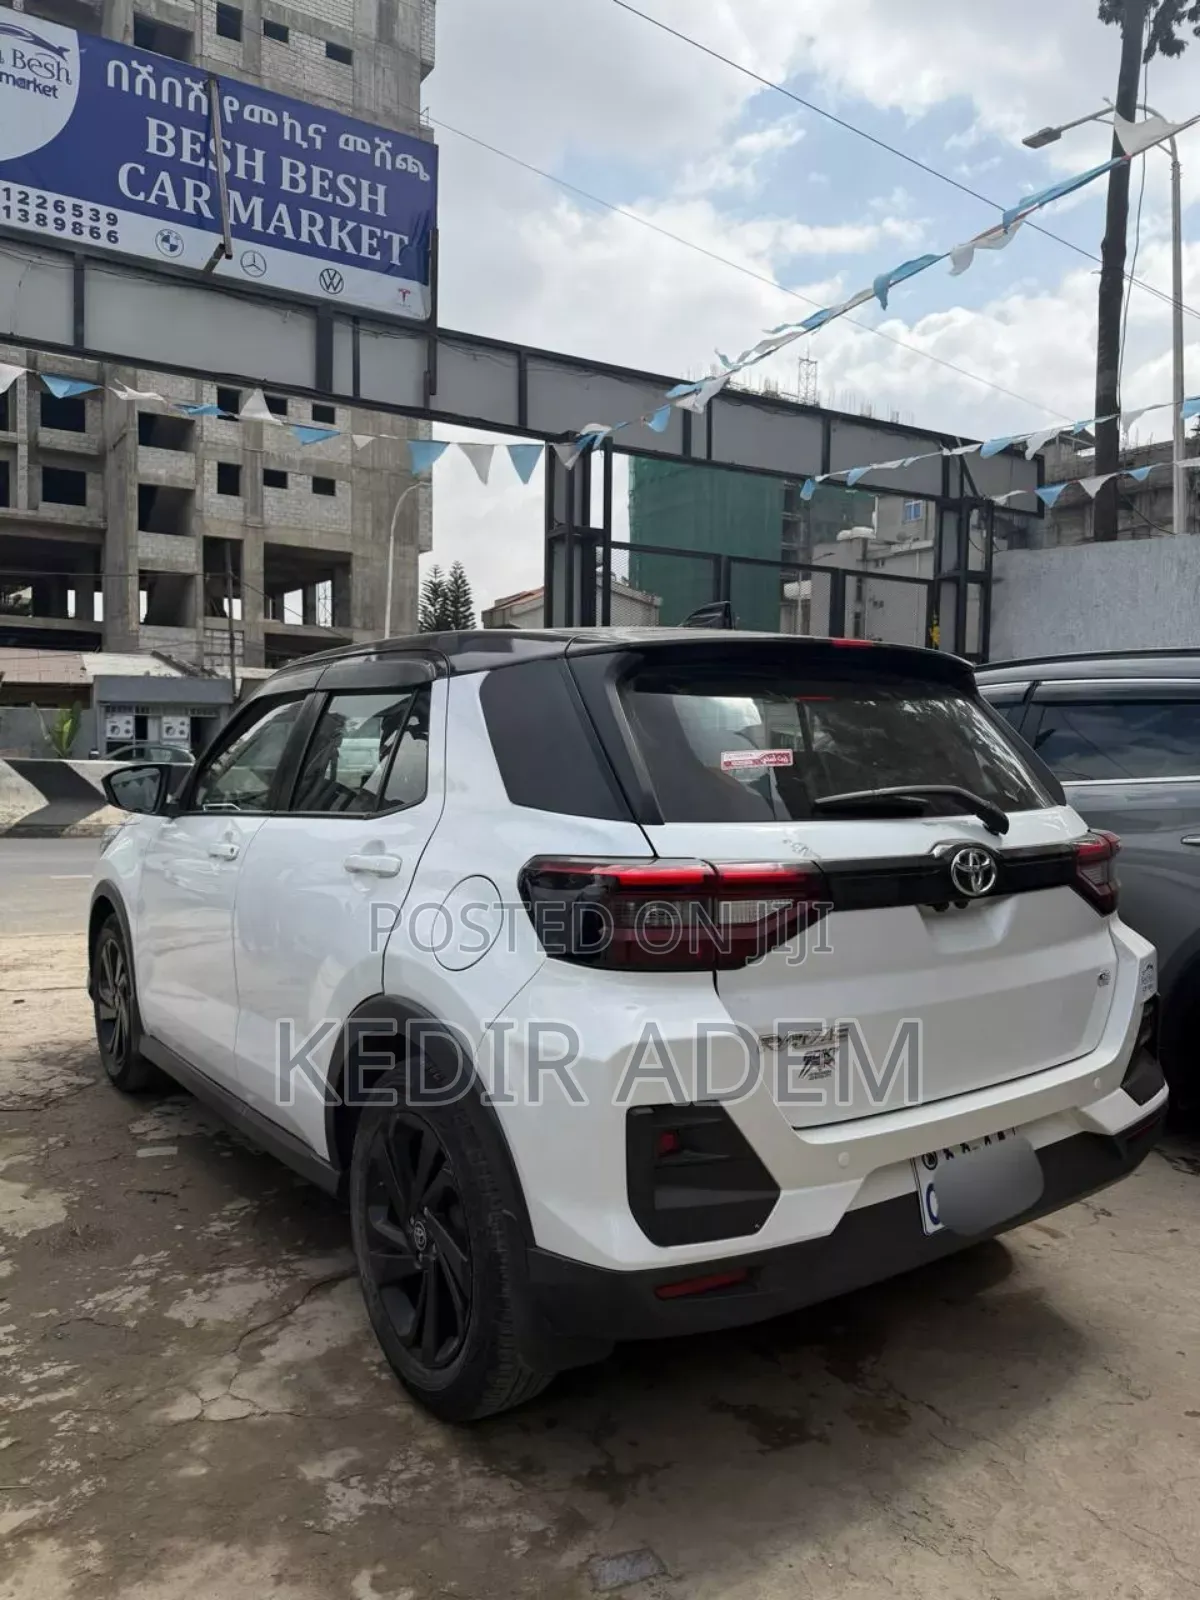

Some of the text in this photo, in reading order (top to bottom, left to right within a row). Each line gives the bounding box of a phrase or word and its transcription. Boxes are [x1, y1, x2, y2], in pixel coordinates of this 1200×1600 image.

[223, 95, 327, 150] የመኪና
[145, 116, 388, 217] BESH BESH
[3, 187, 118, 226] 1226539
[3, 205, 119, 244] 1389866
[118, 162, 409, 266] CAR MARKET
